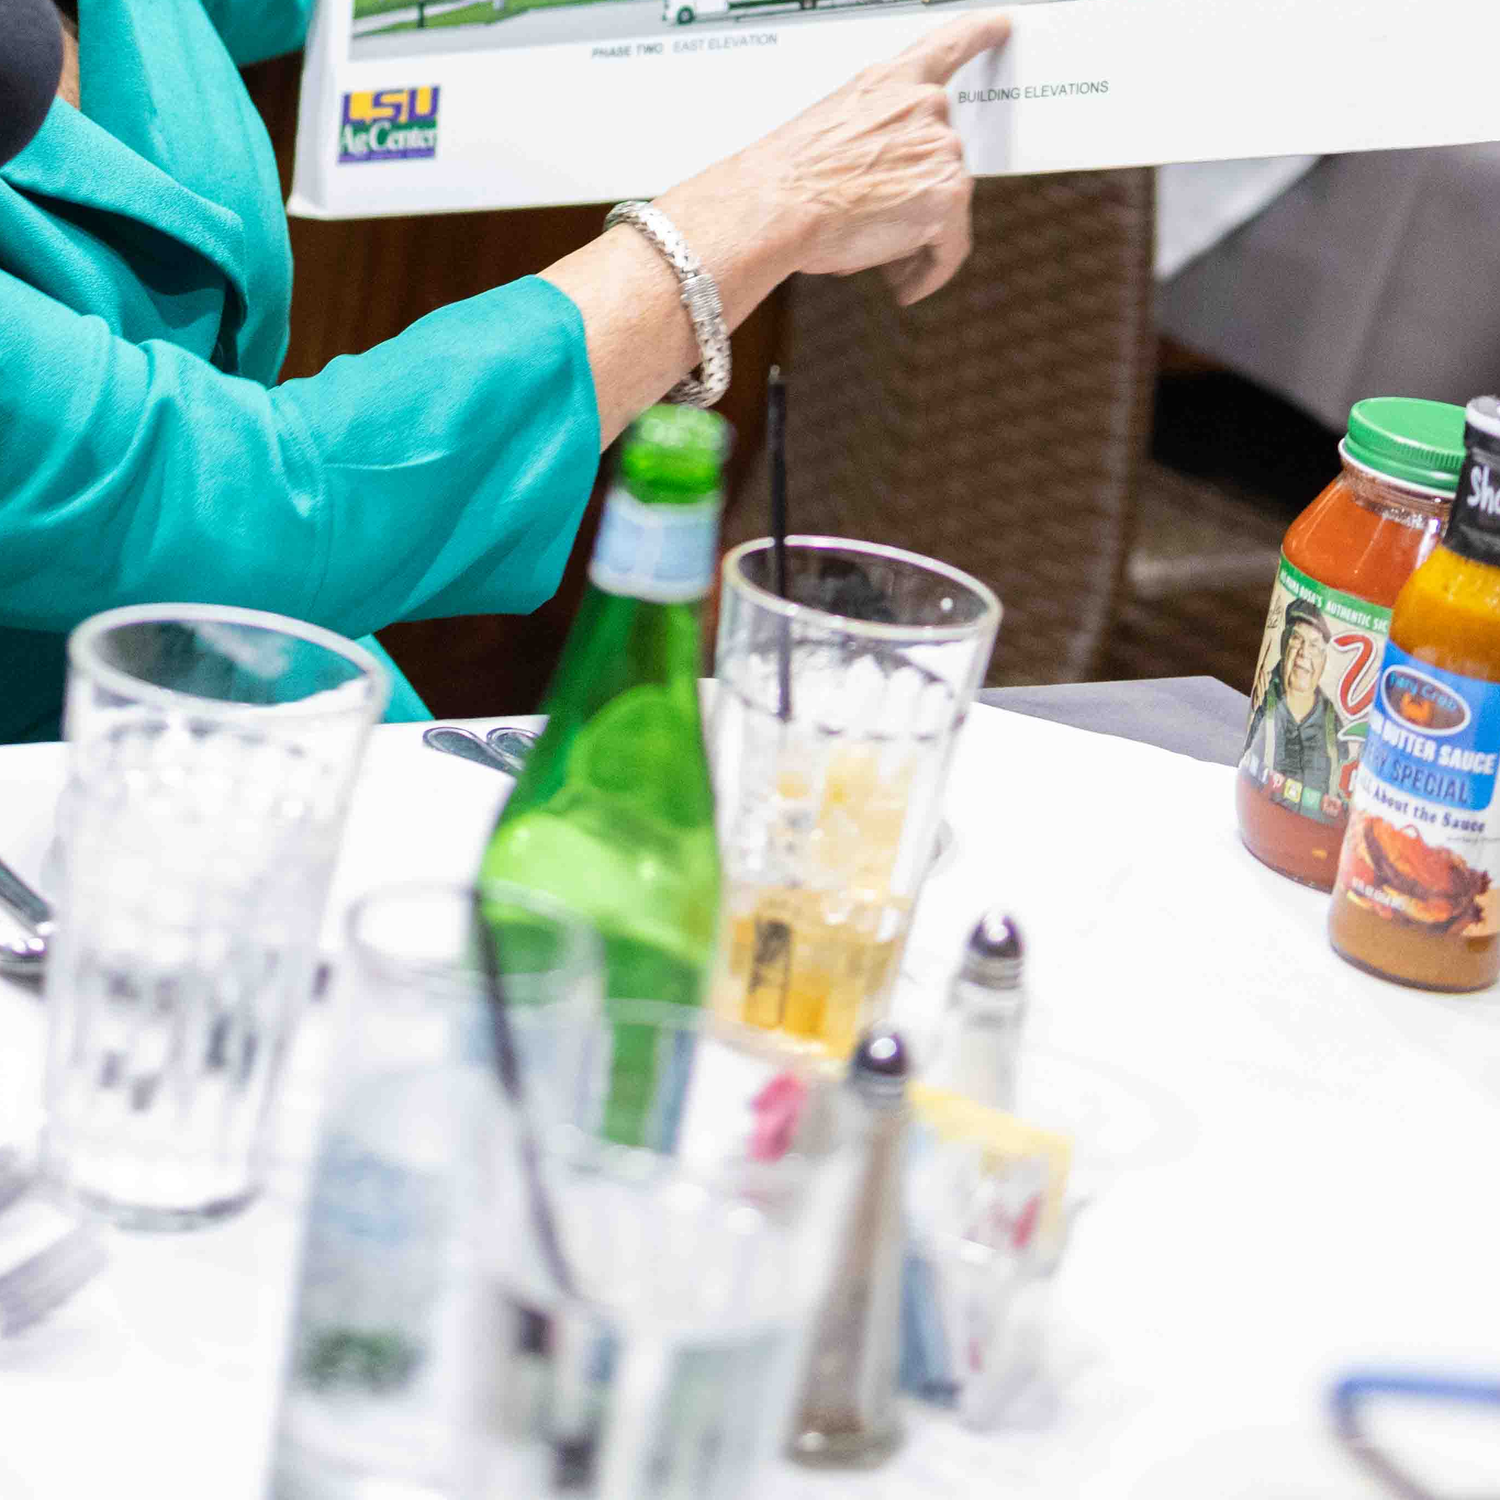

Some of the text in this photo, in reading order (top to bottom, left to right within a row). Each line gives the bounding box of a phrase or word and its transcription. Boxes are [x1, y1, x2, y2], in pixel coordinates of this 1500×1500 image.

[591, 32, 778, 59] PHASE TWO EAST ELEVATION
[958, 79, 1110, 104] BUILDING ELEVATIONS
[1324, 600, 1372, 628] AUTHENTIC
[1381, 722, 1437, 763] BUTTER
[1438, 743, 1498, 775] SAUCE
[1391, 757, 1468, 804] SPECIAL
[1372, 787, 1486, 834] About the Sauce
